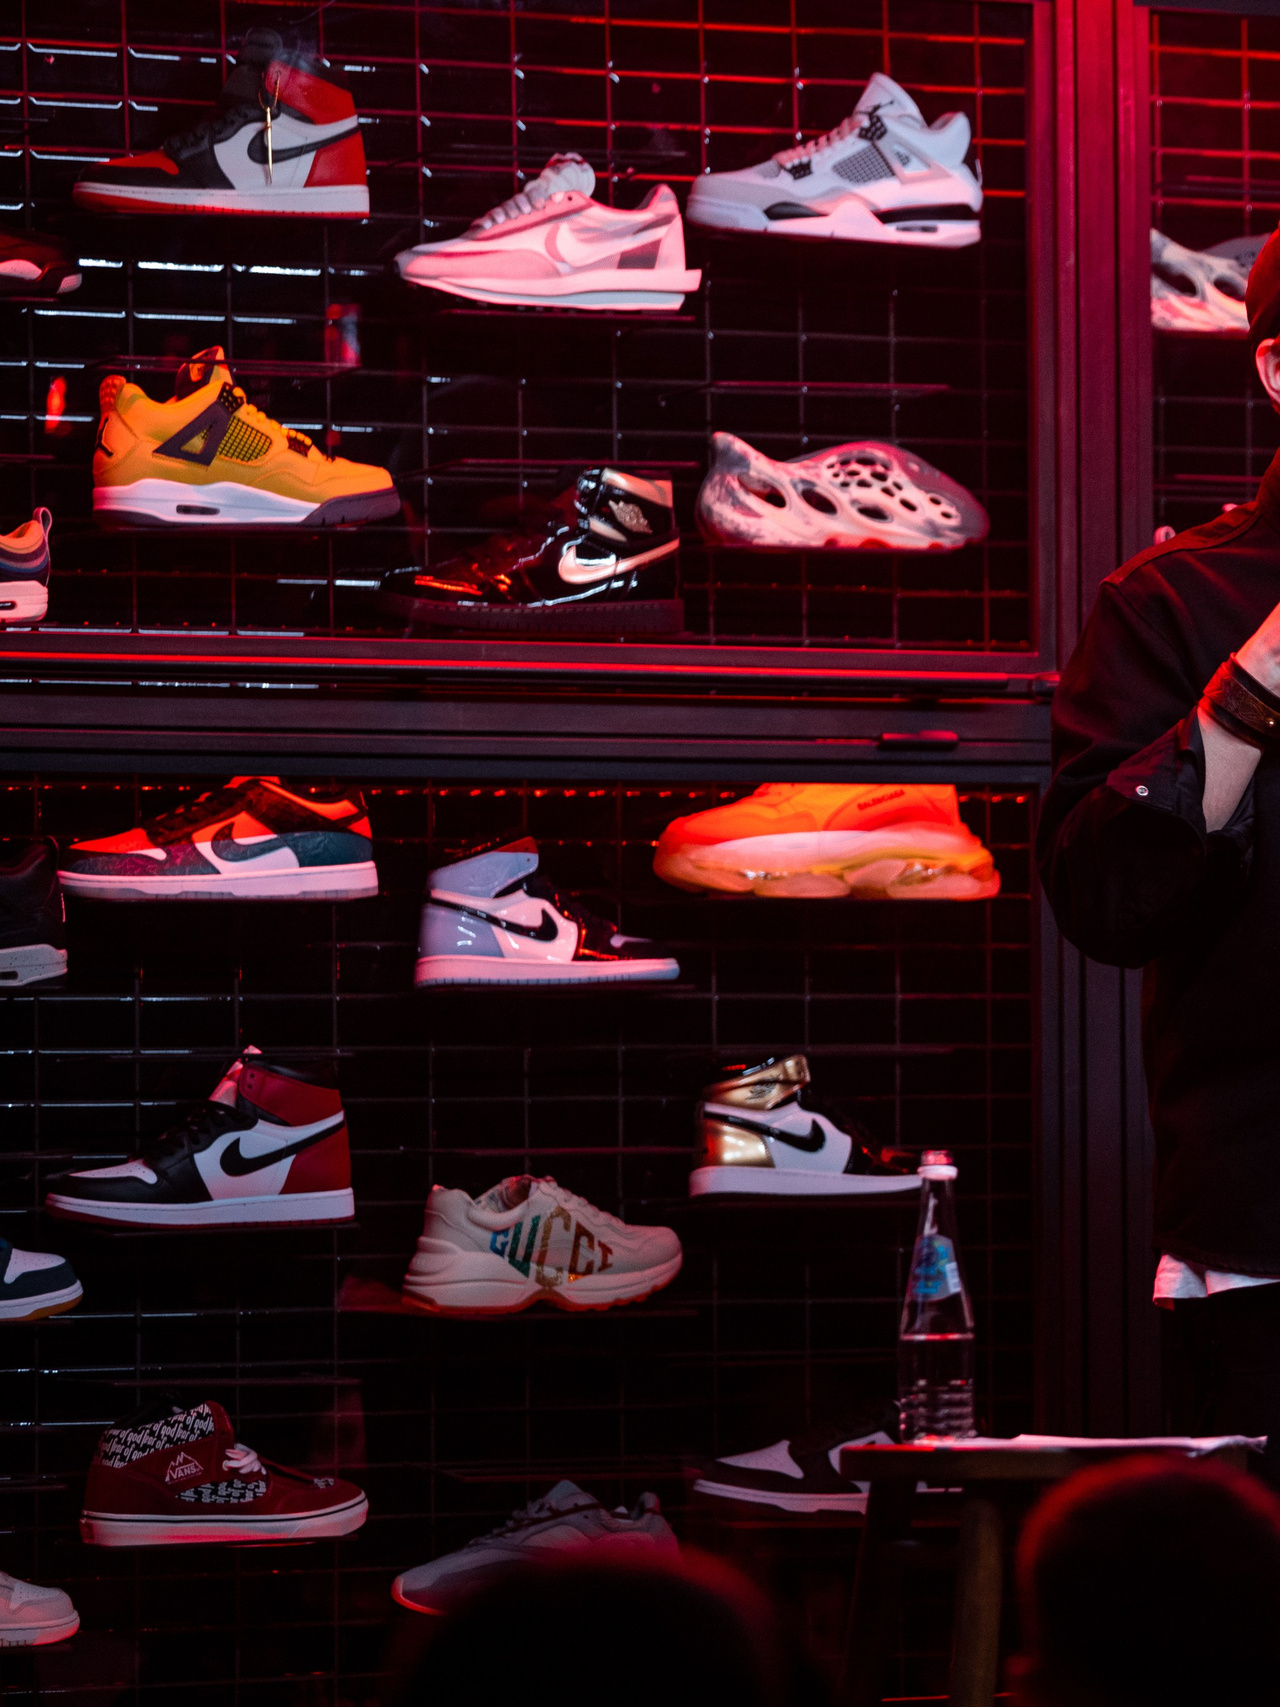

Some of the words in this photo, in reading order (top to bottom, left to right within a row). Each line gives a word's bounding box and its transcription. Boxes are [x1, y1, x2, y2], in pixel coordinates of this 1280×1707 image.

[489, 1205, 614, 1289] GUCCI
[127, 1430, 145, 1446] god
[140, 1429, 157, 1448] fear
[161, 1423, 178, 1439] god
[173, 1423, 190, 1442] fear
[169, 1462, 196, 1479] VANS
